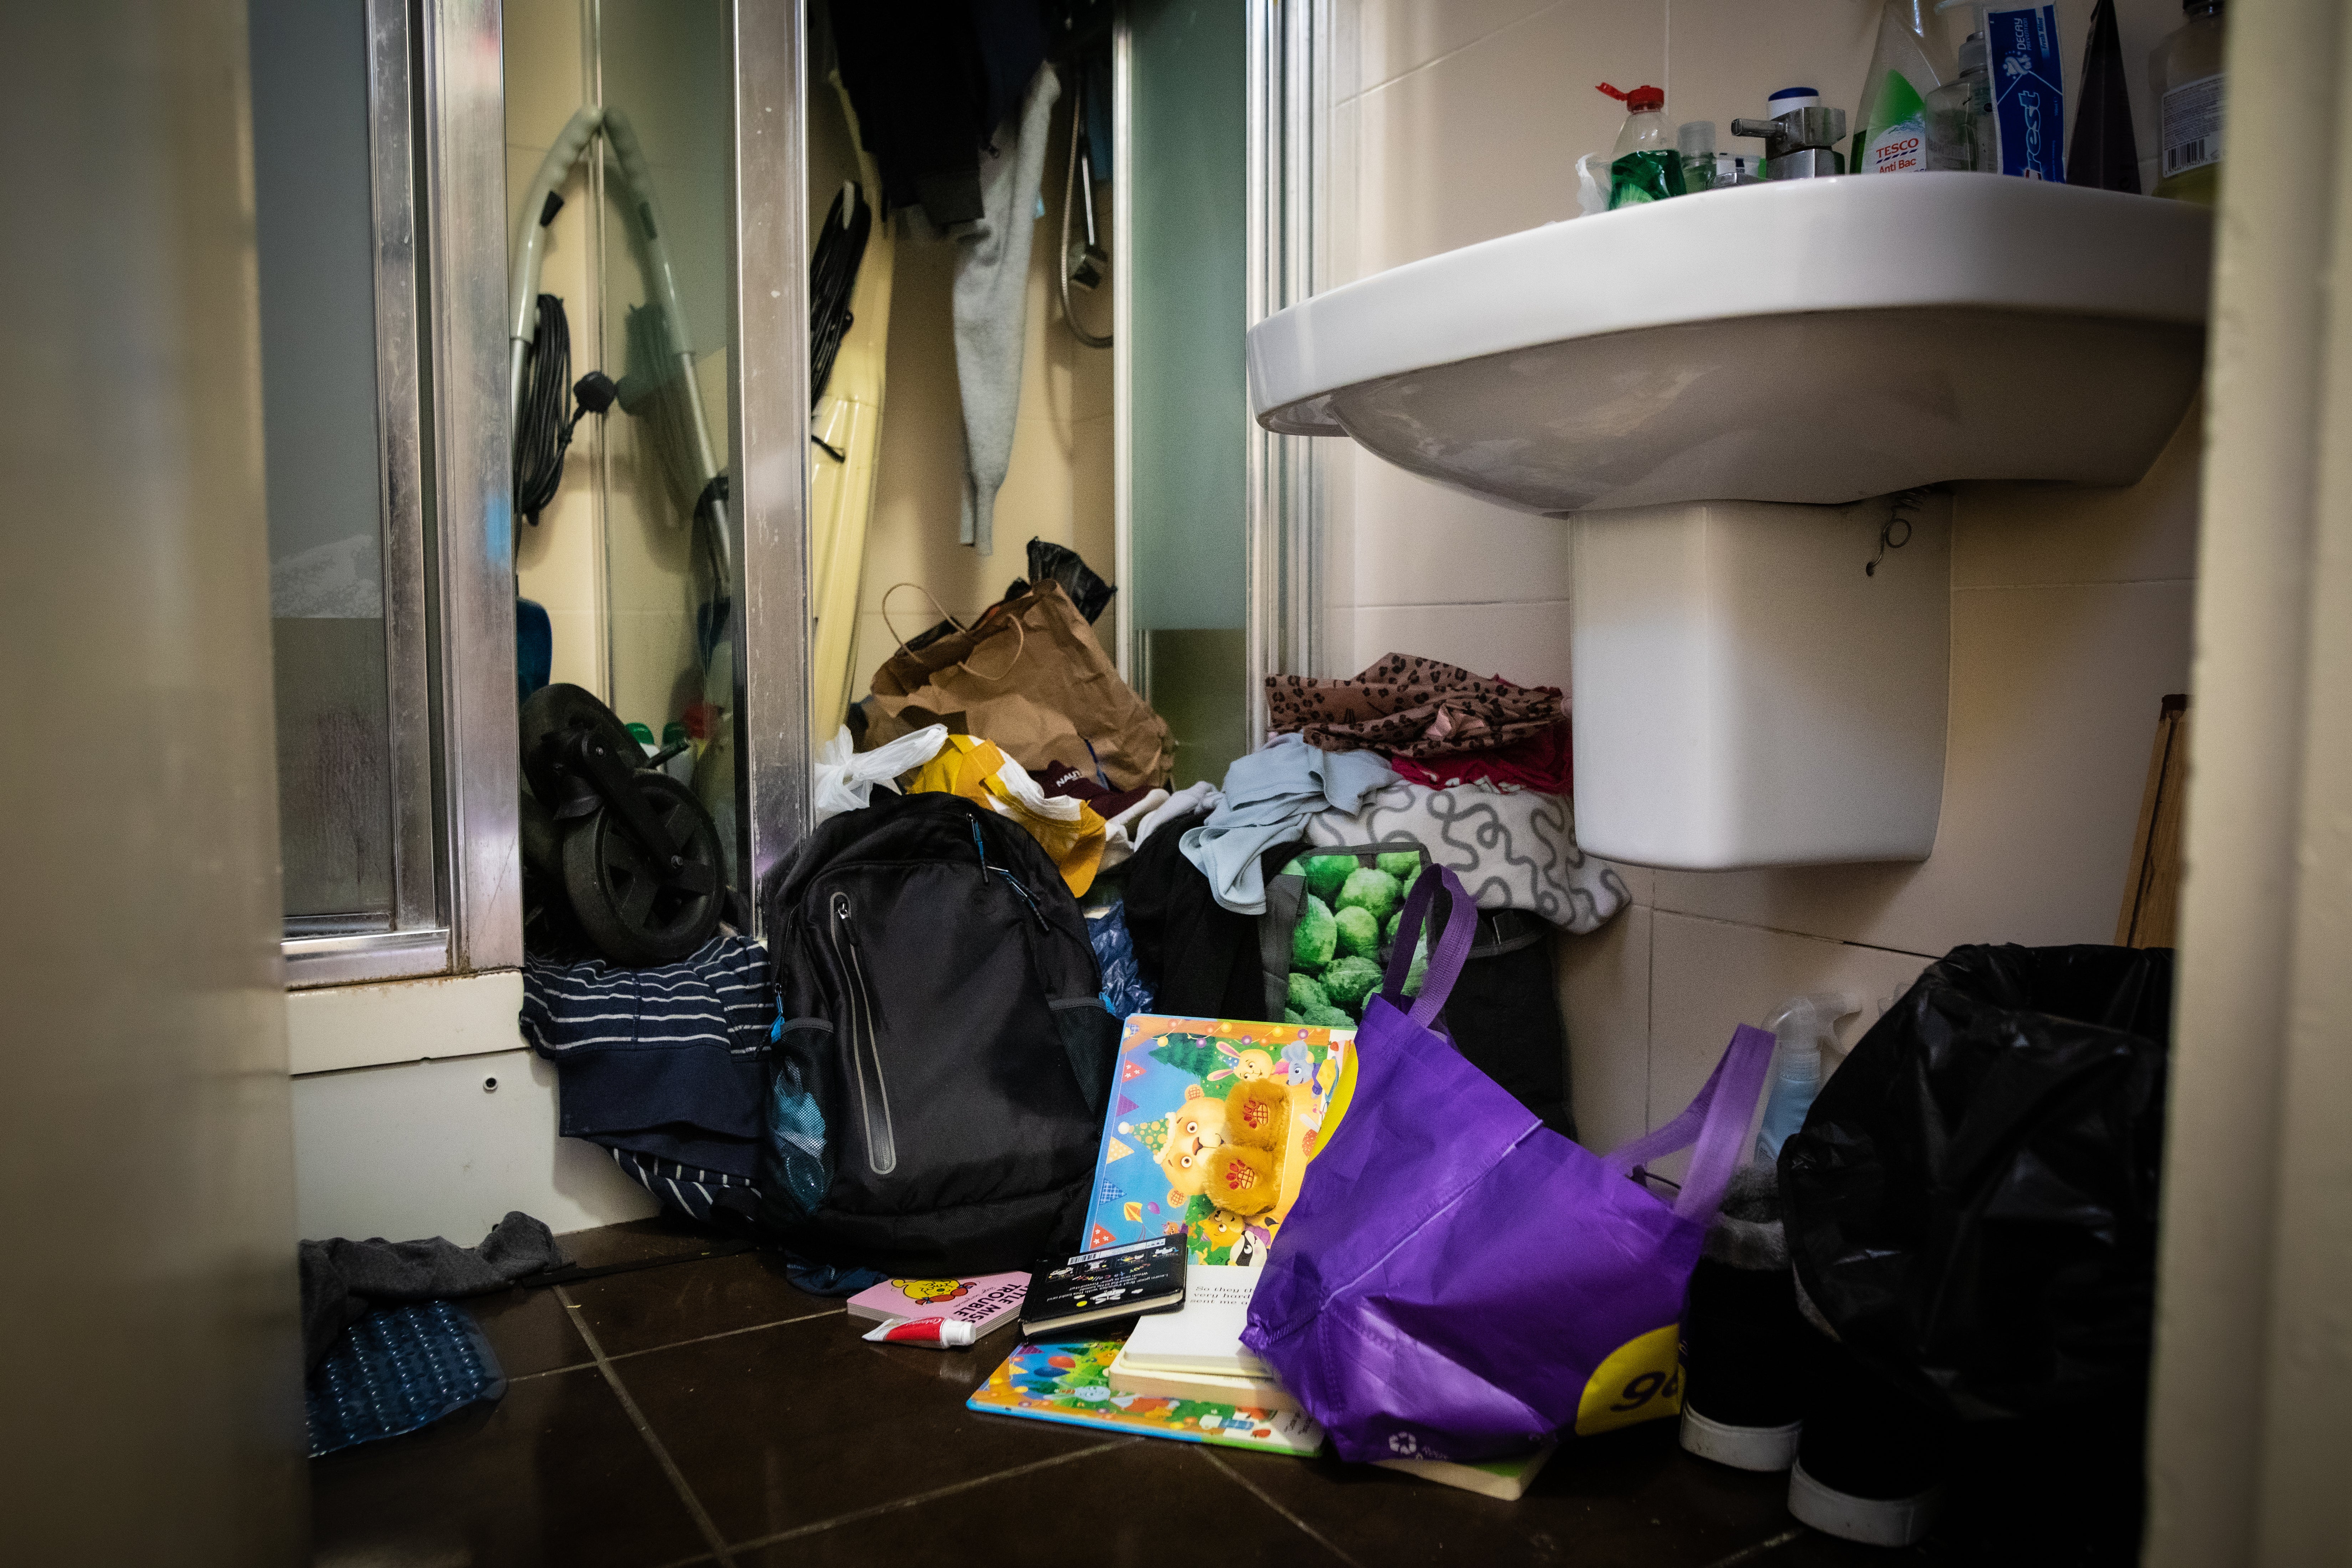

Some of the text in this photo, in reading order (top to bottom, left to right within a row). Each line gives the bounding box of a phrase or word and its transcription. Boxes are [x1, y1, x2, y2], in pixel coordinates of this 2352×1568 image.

[2014, 17, 2027, 50] DECAY
[2023, 18, 2032, 51] PREVENTION
[2039, 33, 2048, 49] Fresh
[1876, 138, 1919, 158] TESCO
[1879, 161, 1896, 174] Anti
[1898, 158, 1917, 169] Bac
[953, 1284, 1022, 1317] TROUBLE
